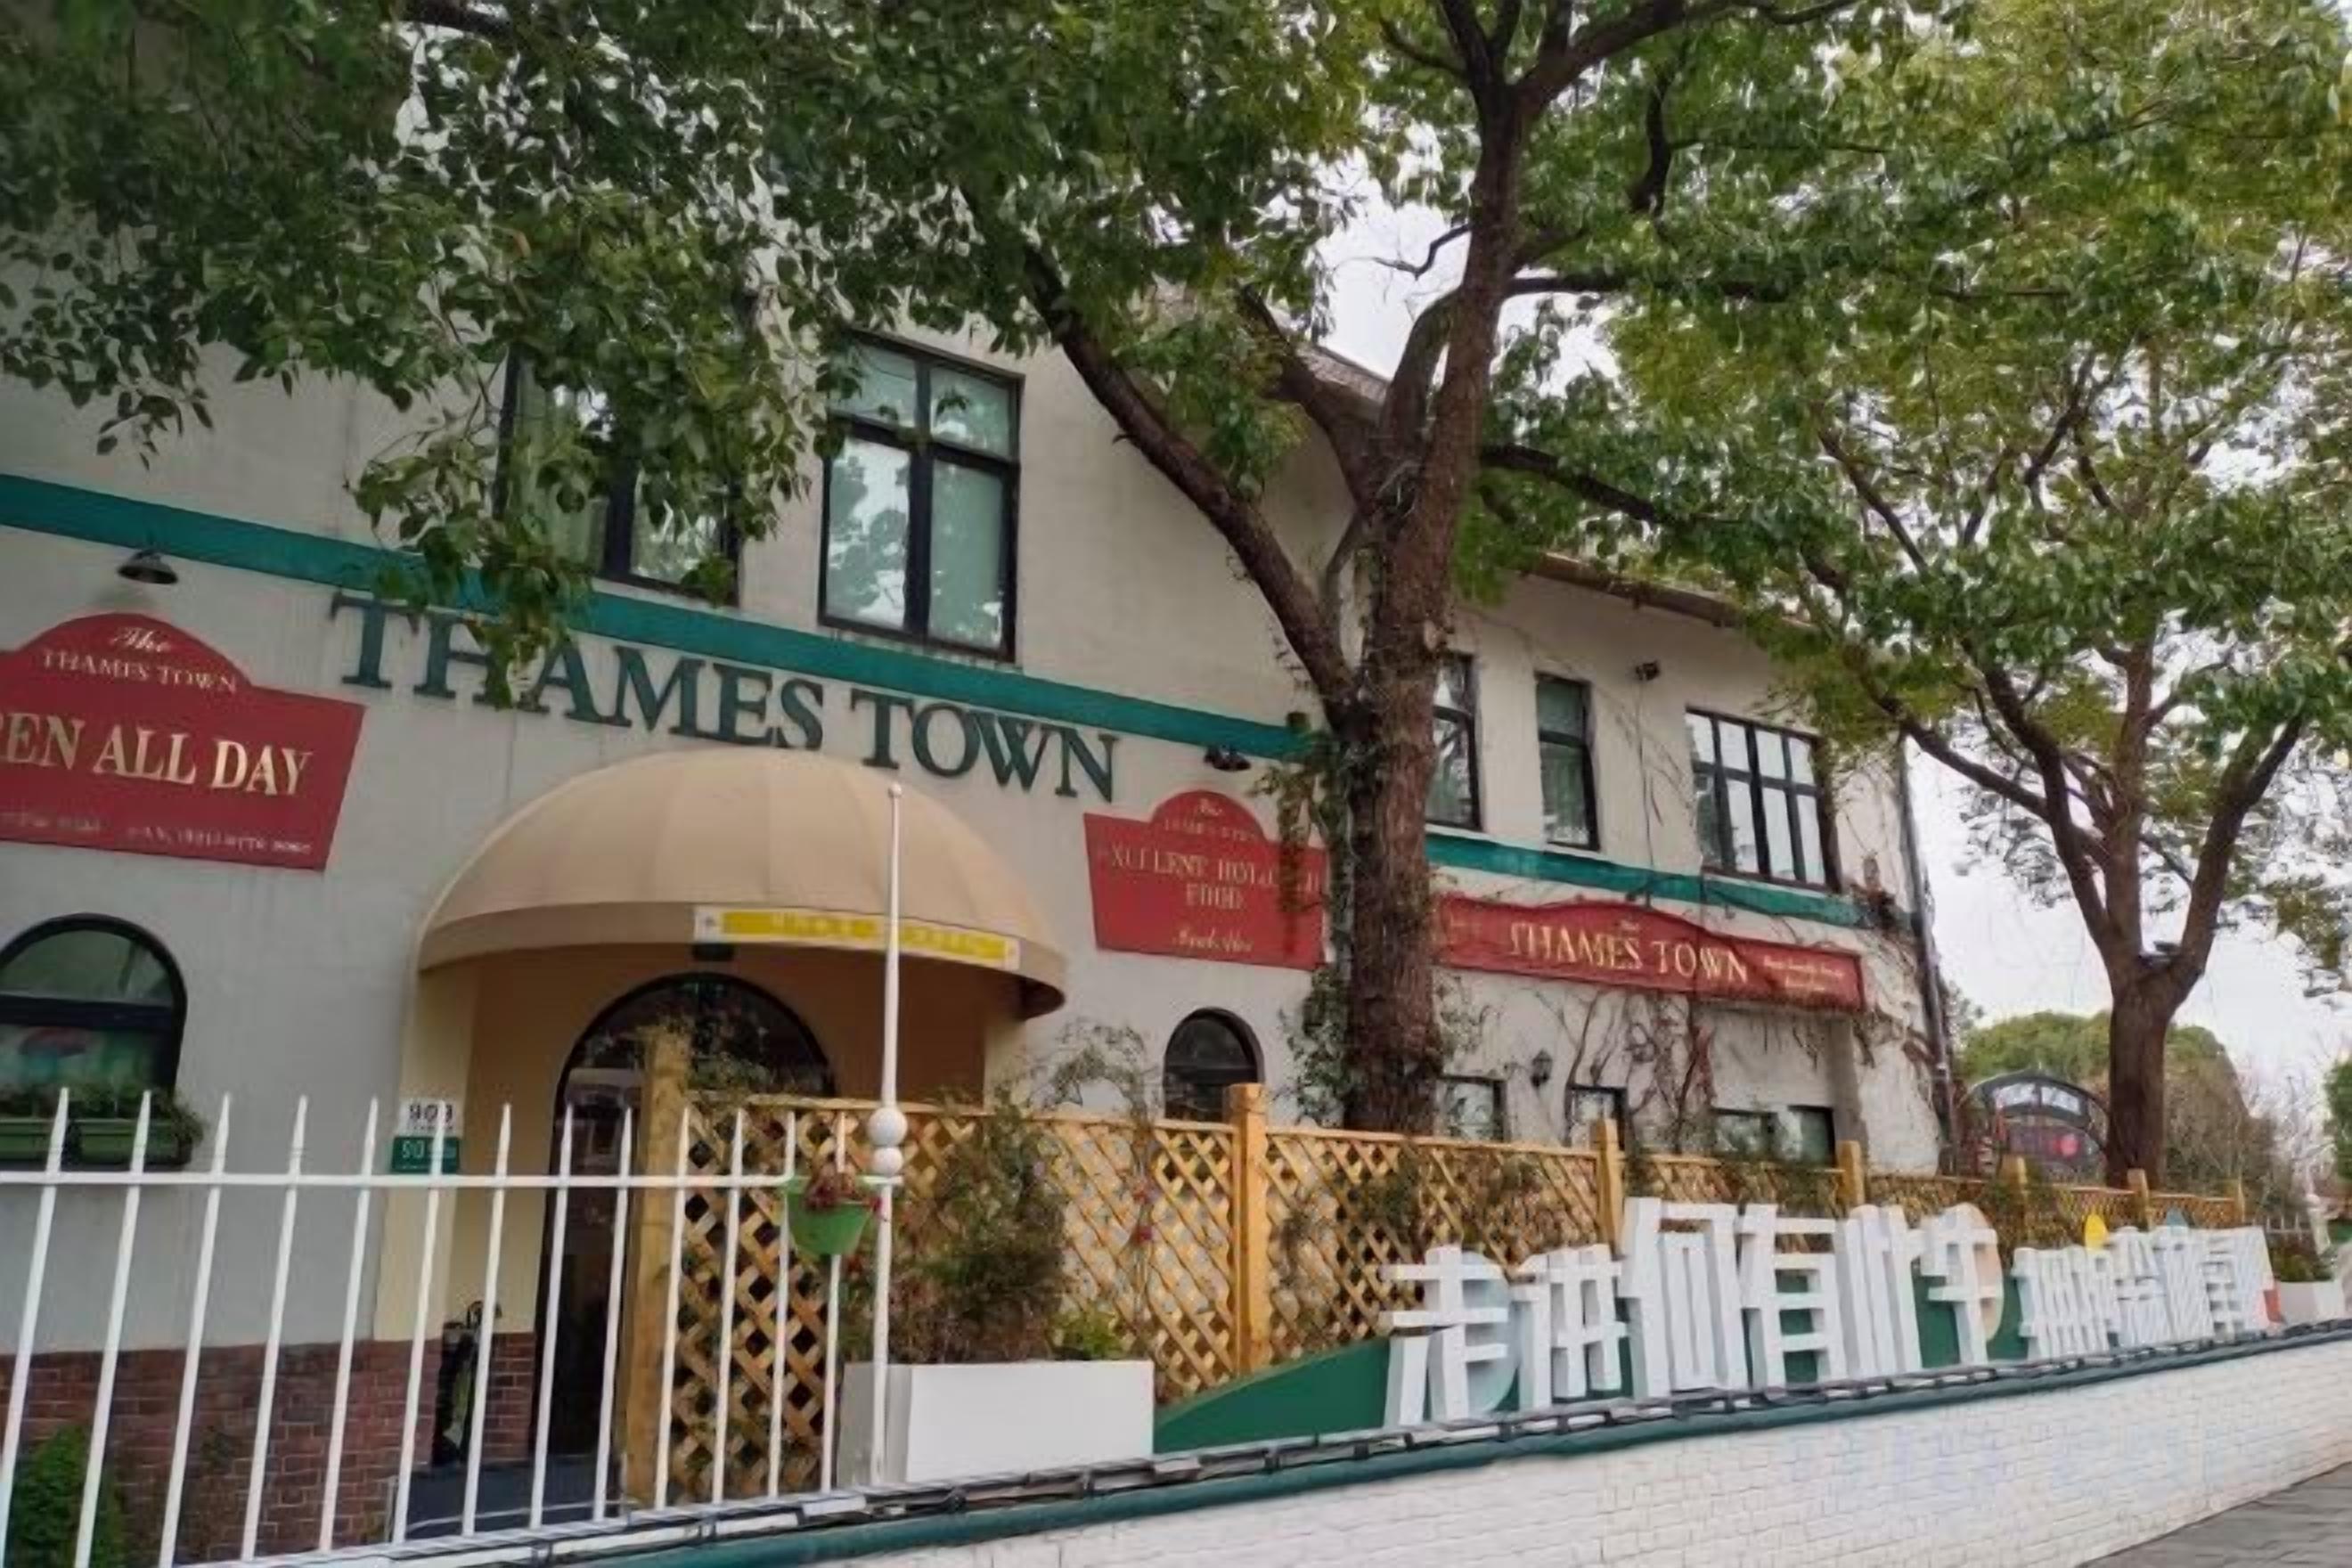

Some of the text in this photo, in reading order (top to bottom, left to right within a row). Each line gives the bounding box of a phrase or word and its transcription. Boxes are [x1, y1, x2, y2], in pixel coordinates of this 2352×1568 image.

[43, 648, 237, 694] THAMES TOWN
[110, 625, 173, 653] The
[331, 592, 1119, 802] THAMES TOWN
[0, 711, 314, 796] EN ALL DAY
[1510, 920, 1644, 969] THAMES
[1651, 939, 1749, 984] TOWN
